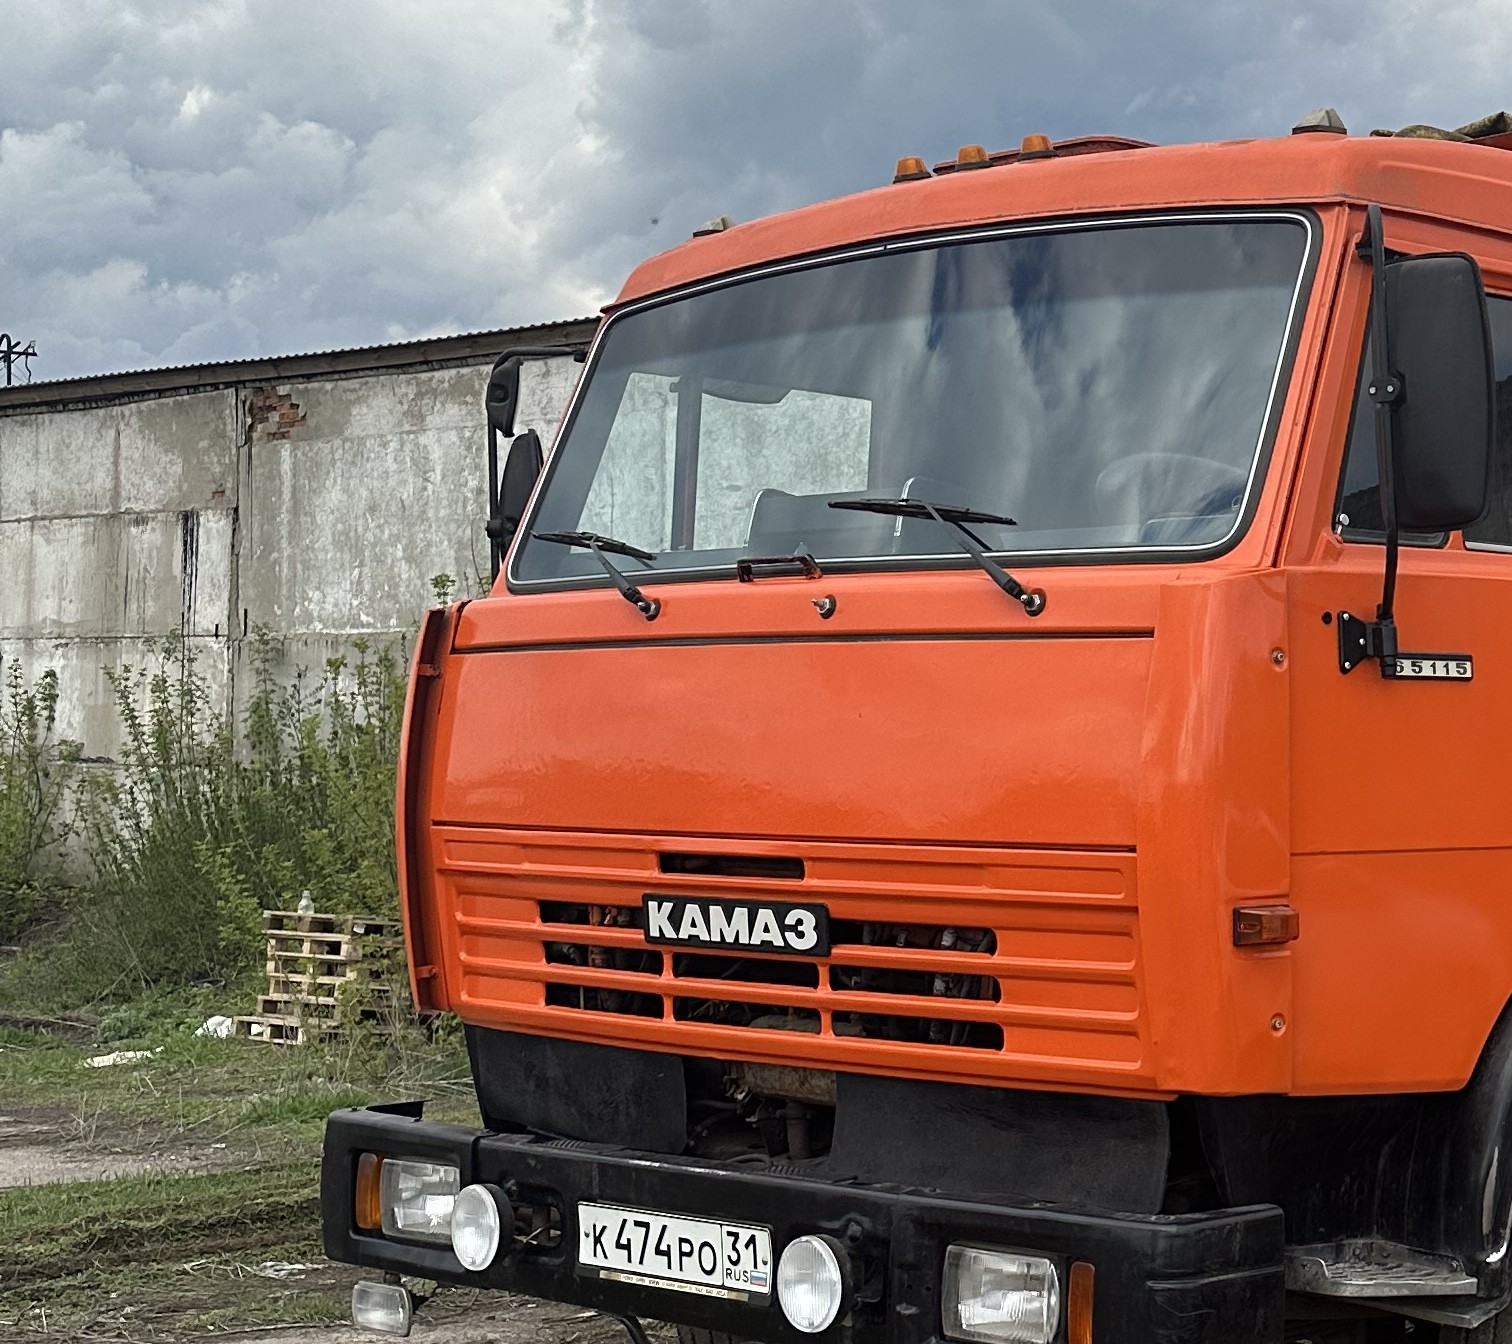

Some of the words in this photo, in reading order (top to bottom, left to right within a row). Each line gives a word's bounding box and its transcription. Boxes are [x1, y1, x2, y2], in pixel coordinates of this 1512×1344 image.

[647, 900, 818, 951] КАМАЗ
[725, 1230, 758, 1270] 31
[725, 1267, 750, 1283] RUS
